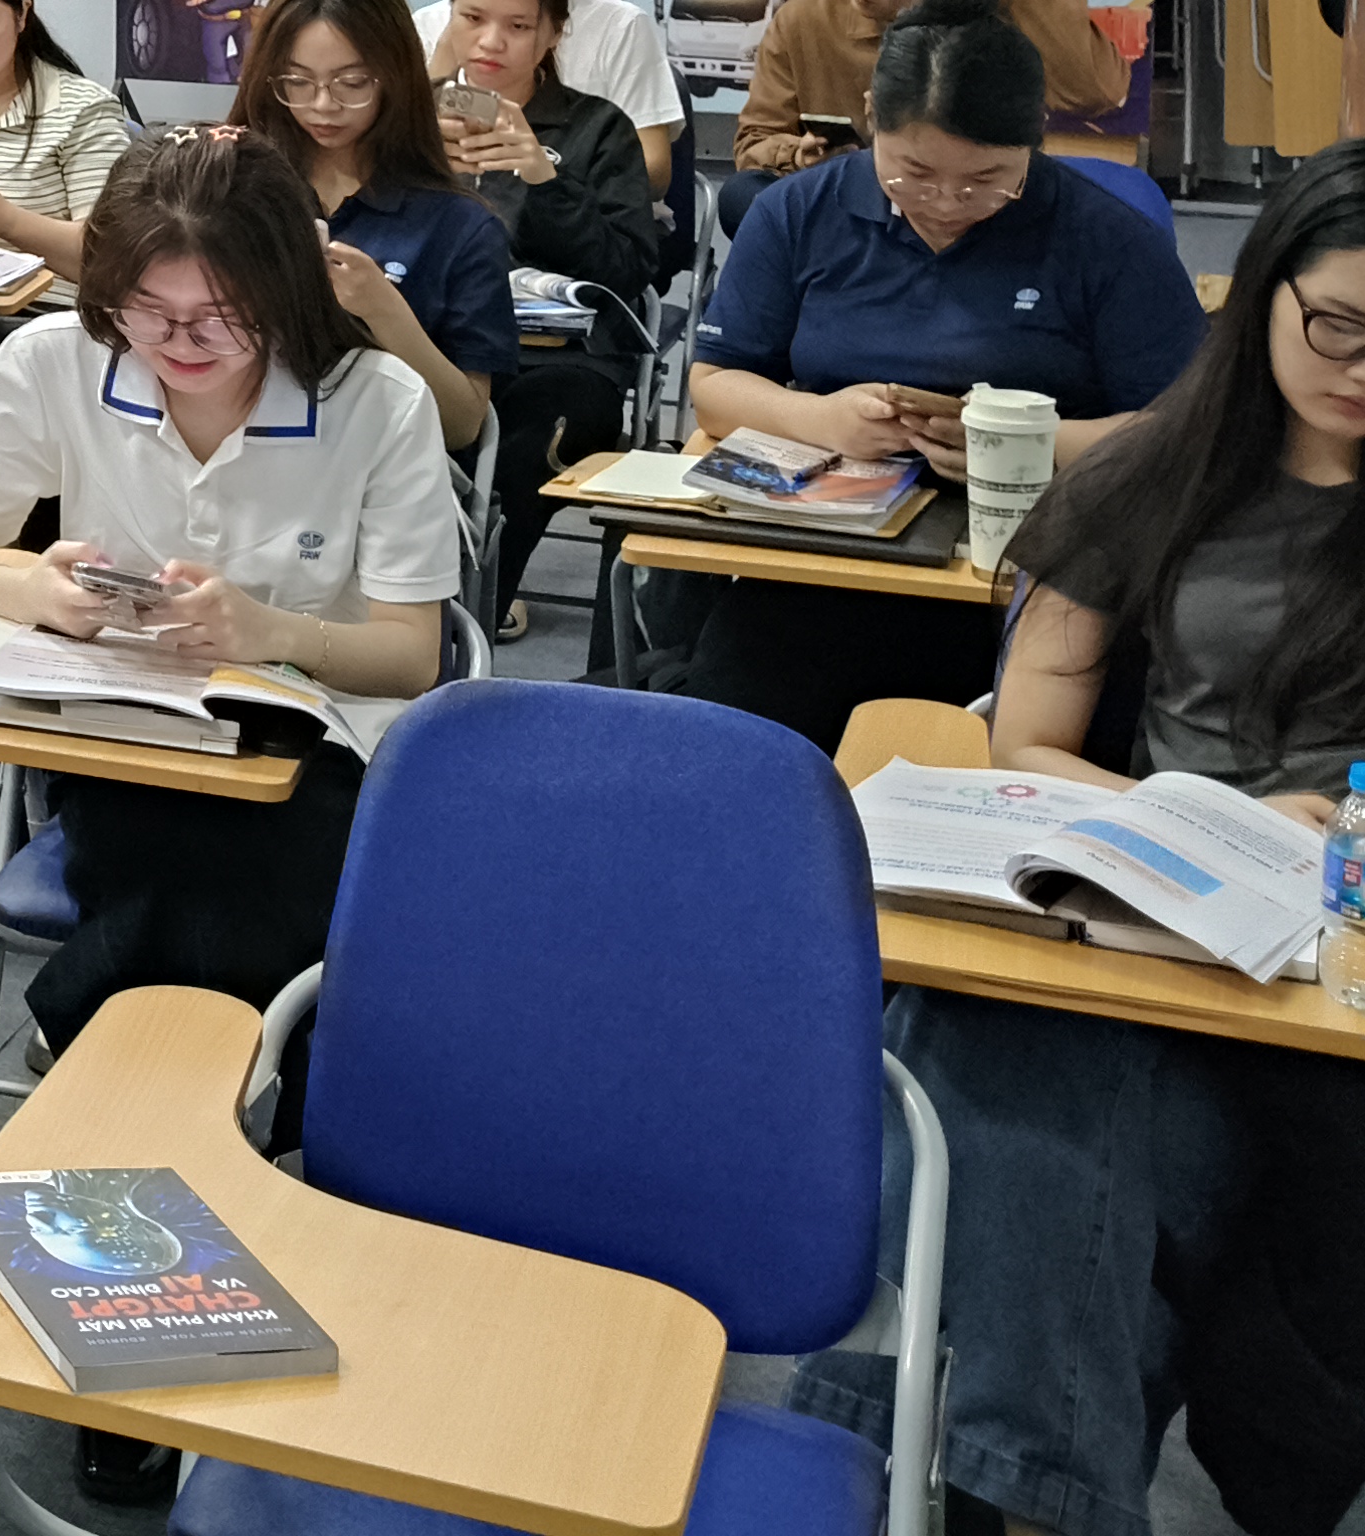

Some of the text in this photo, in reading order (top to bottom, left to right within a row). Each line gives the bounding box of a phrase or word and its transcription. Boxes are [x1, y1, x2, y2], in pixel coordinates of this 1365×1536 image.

[300, 550, 321, 560] FAW
[160, 1273, 204, 1293] AI
[211, 1277, 248, 1290] VÀ
[50, 1285, 101, 1299] CAO
[67, 1290, 262, 1320] CHATGPT
[78, 1309, 279, 1333] KHÁM PHÁ BÍ MẬT
